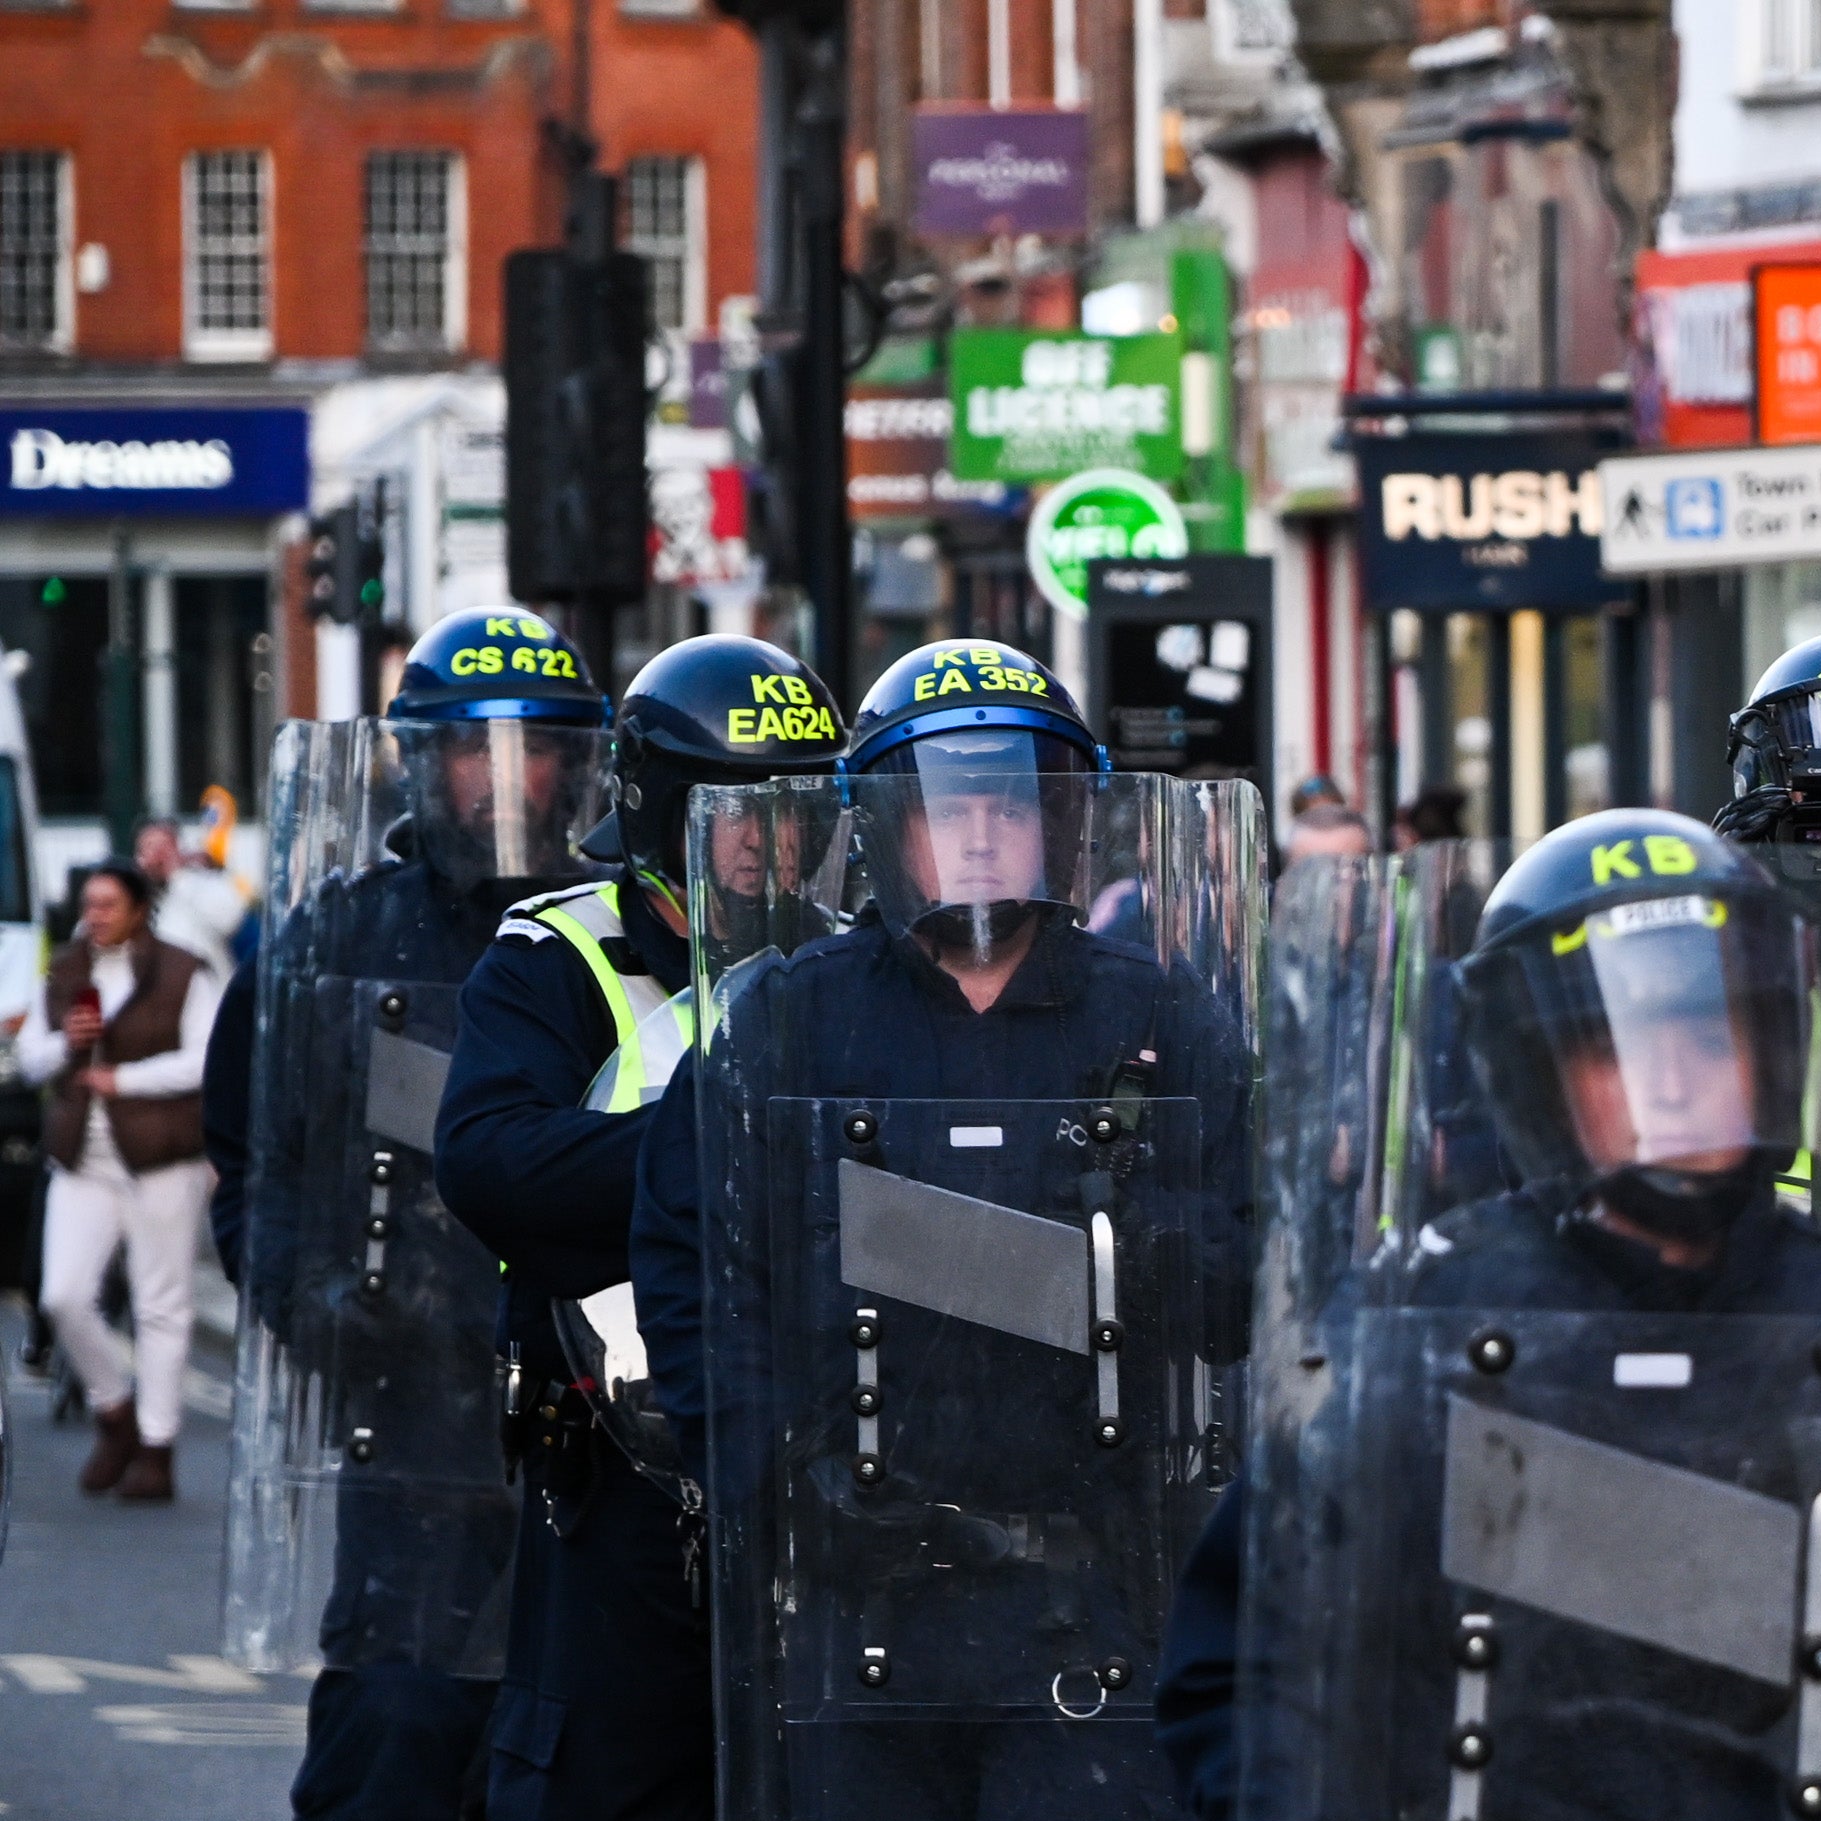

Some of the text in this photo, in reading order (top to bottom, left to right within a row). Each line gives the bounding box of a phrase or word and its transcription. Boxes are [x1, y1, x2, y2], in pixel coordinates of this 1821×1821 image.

[9, 429, 234, 490] Dreams
[1736, 471, 1810, 497] Town
[1381, 470, 1602, 540] RUSH
[1736, 509, 1788, 538] Car
[486, 617, 548, 640] KB
[451, 646, 578, 679] CS 622
[933, 648, 1002, 670] KB
[750, 674, 814, 706] KB
[914, 665, 1050, 702] EA 352
[728, 706, 836, 743] EA624
[1590, 834, 1697, 887] KB
